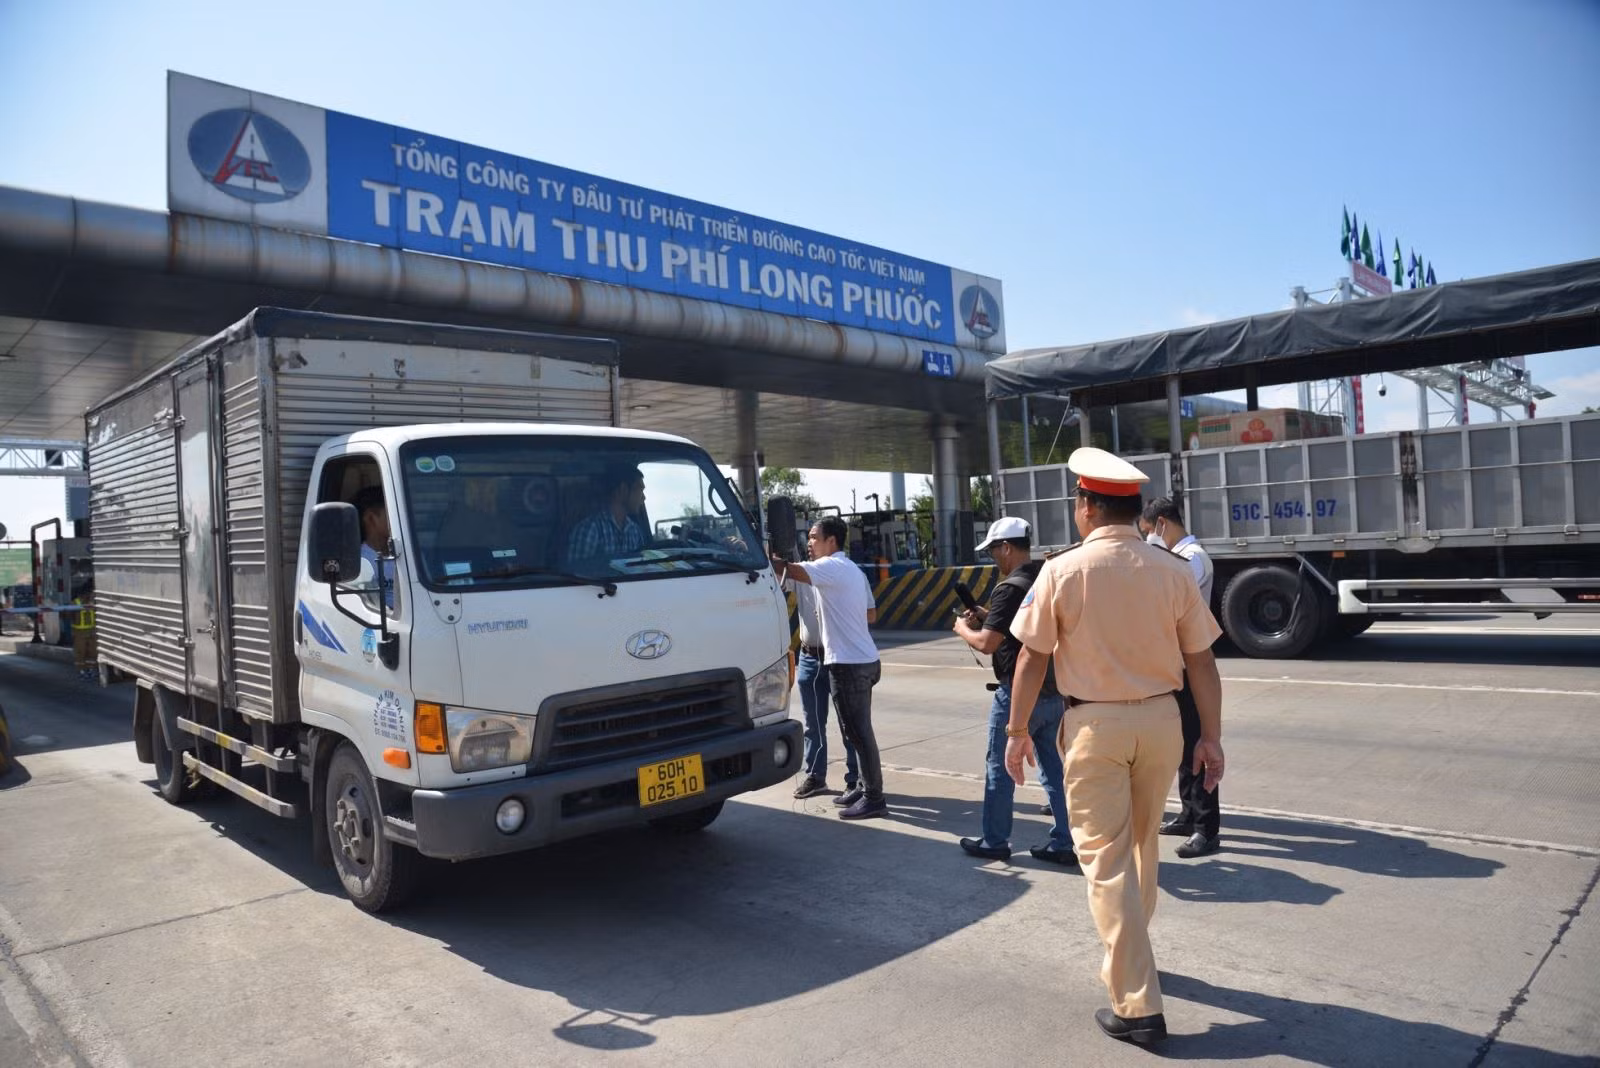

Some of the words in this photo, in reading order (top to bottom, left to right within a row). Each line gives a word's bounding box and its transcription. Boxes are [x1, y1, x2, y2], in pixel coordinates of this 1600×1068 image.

[361, 179, 537, 253] TRẠM
[552, 218, 648, 273] THU
[660, 240, 732, 289] PHÍ
[739, 258, 834, 309] LONG
[842, 287, 942, 330] PHƯỚC
[391, 138, 458, 179] TỔNG
[466, 160, 530, 195] CÔNG
[537, 177, 565, 202] TY
[572, 183, 612, 213] ĐẦU
[618, 196, 644, 220] TƯ
[650, 205, 695, 232] PHÁT
[701, 215, 749, 244] TRIỂN
[752, 229, 804, 257] ĐƯỜNG
[808, 243, 836, 265] CAO
[839, 248, 867, 271] TỐC
[868, 257, 896, 280] VIỆT
[898, 265, 926, 286] NAM
[657, 760, 686, 781] 60H
